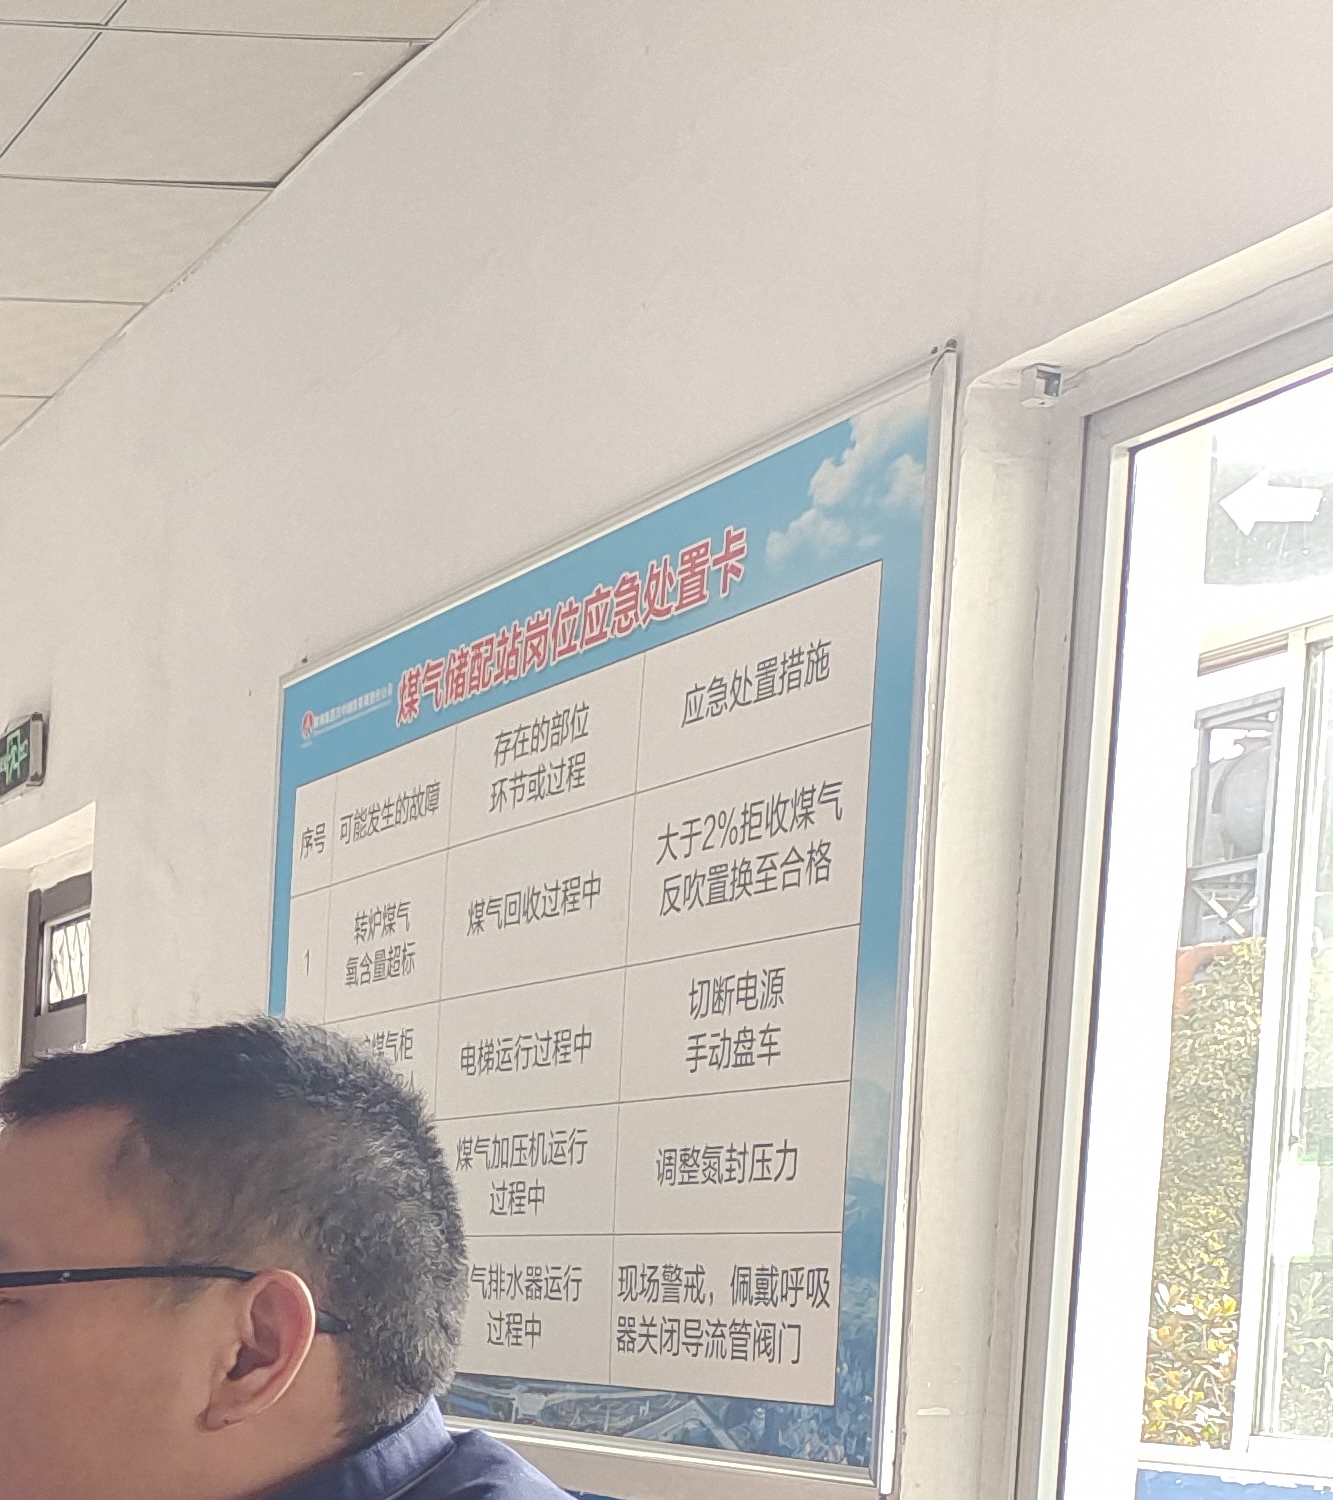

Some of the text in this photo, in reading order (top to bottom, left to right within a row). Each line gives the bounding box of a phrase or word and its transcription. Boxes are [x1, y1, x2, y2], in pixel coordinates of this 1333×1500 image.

[395, 525, 748, 727] 煤气储配站岗位应急处置卡
[681, 639, 832, 729] 应急处置措施
[493, 702, 590, 770] 存在的部位
[490, 752, 587, 814] 环节或过程
[339, 780, 441, 846] 可能发生的故障
[656, 780, 844, 865] 大于2%拒收煤气
[298, 828, 326, 860] 序号
[659, 840, 832, 917] 反吹置换至合格
[354, 900, 411, 944] 转炉煤气
[466, 870, 602, 938] 煤气回收过程中
[303, 949, 310, 976] 1
[688, 966, 786, 1022] 切断电源
[363, 1028, 414, 1061] 煤气柜
[460, 1023, 593, 1078] 电梯运行过程中
[685, 1025, 782, 1075] 手动盘车
[456, 1127, 588, 1172] 煤气加压机运行
[656, 1140, 798, 1189] 调整氮封压力
[489, 1180, 546, 1218] 过程中
[465, 1263, 582, 1304] 气排水器运行
[486, 1313, 542, 1349] 过程中
[616, 1316, 802, 1364] 器关闭导流管阀门
